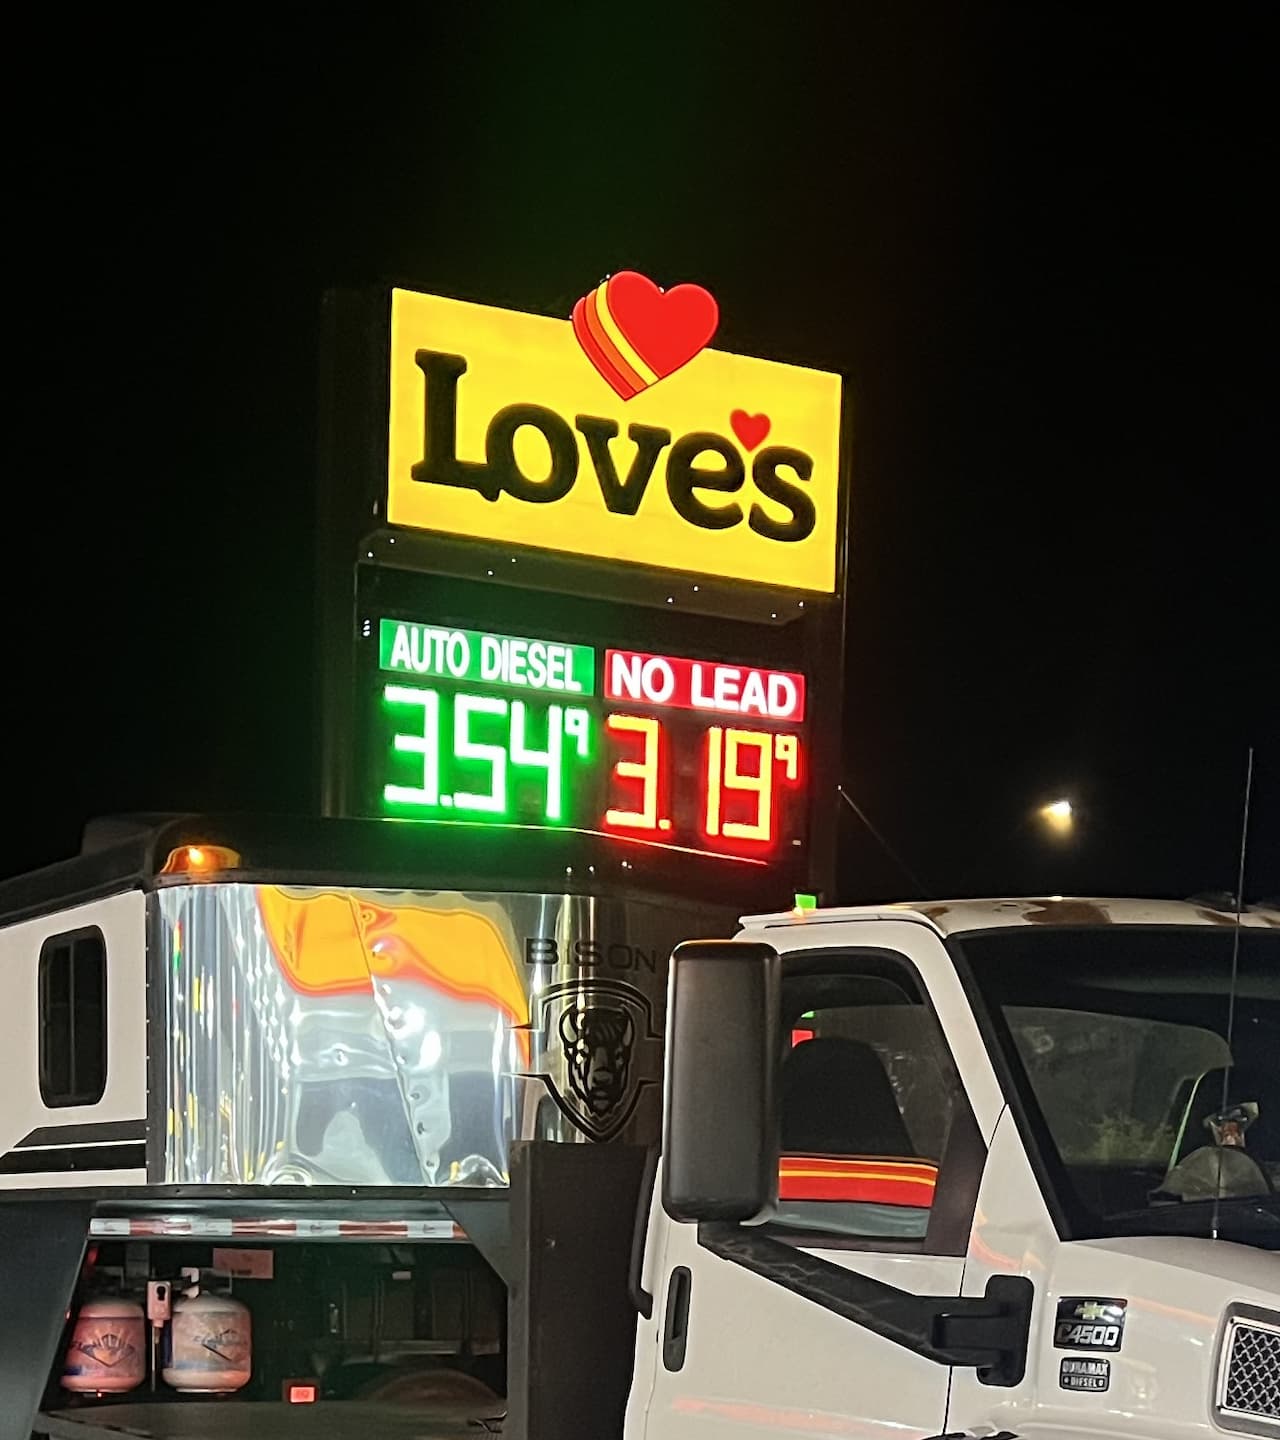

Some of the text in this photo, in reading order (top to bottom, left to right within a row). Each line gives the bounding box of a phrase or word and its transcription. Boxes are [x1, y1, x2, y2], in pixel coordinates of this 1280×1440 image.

[390, 624, 582, 692] AUTO DIESEL
[612, 653, 797, 717] NO LEAD
[525, 937, 657, 974] BISON
[1055, 1323, 1120, 1347] C4500
[1070, 1377, 1097, 1388] DIESEL
